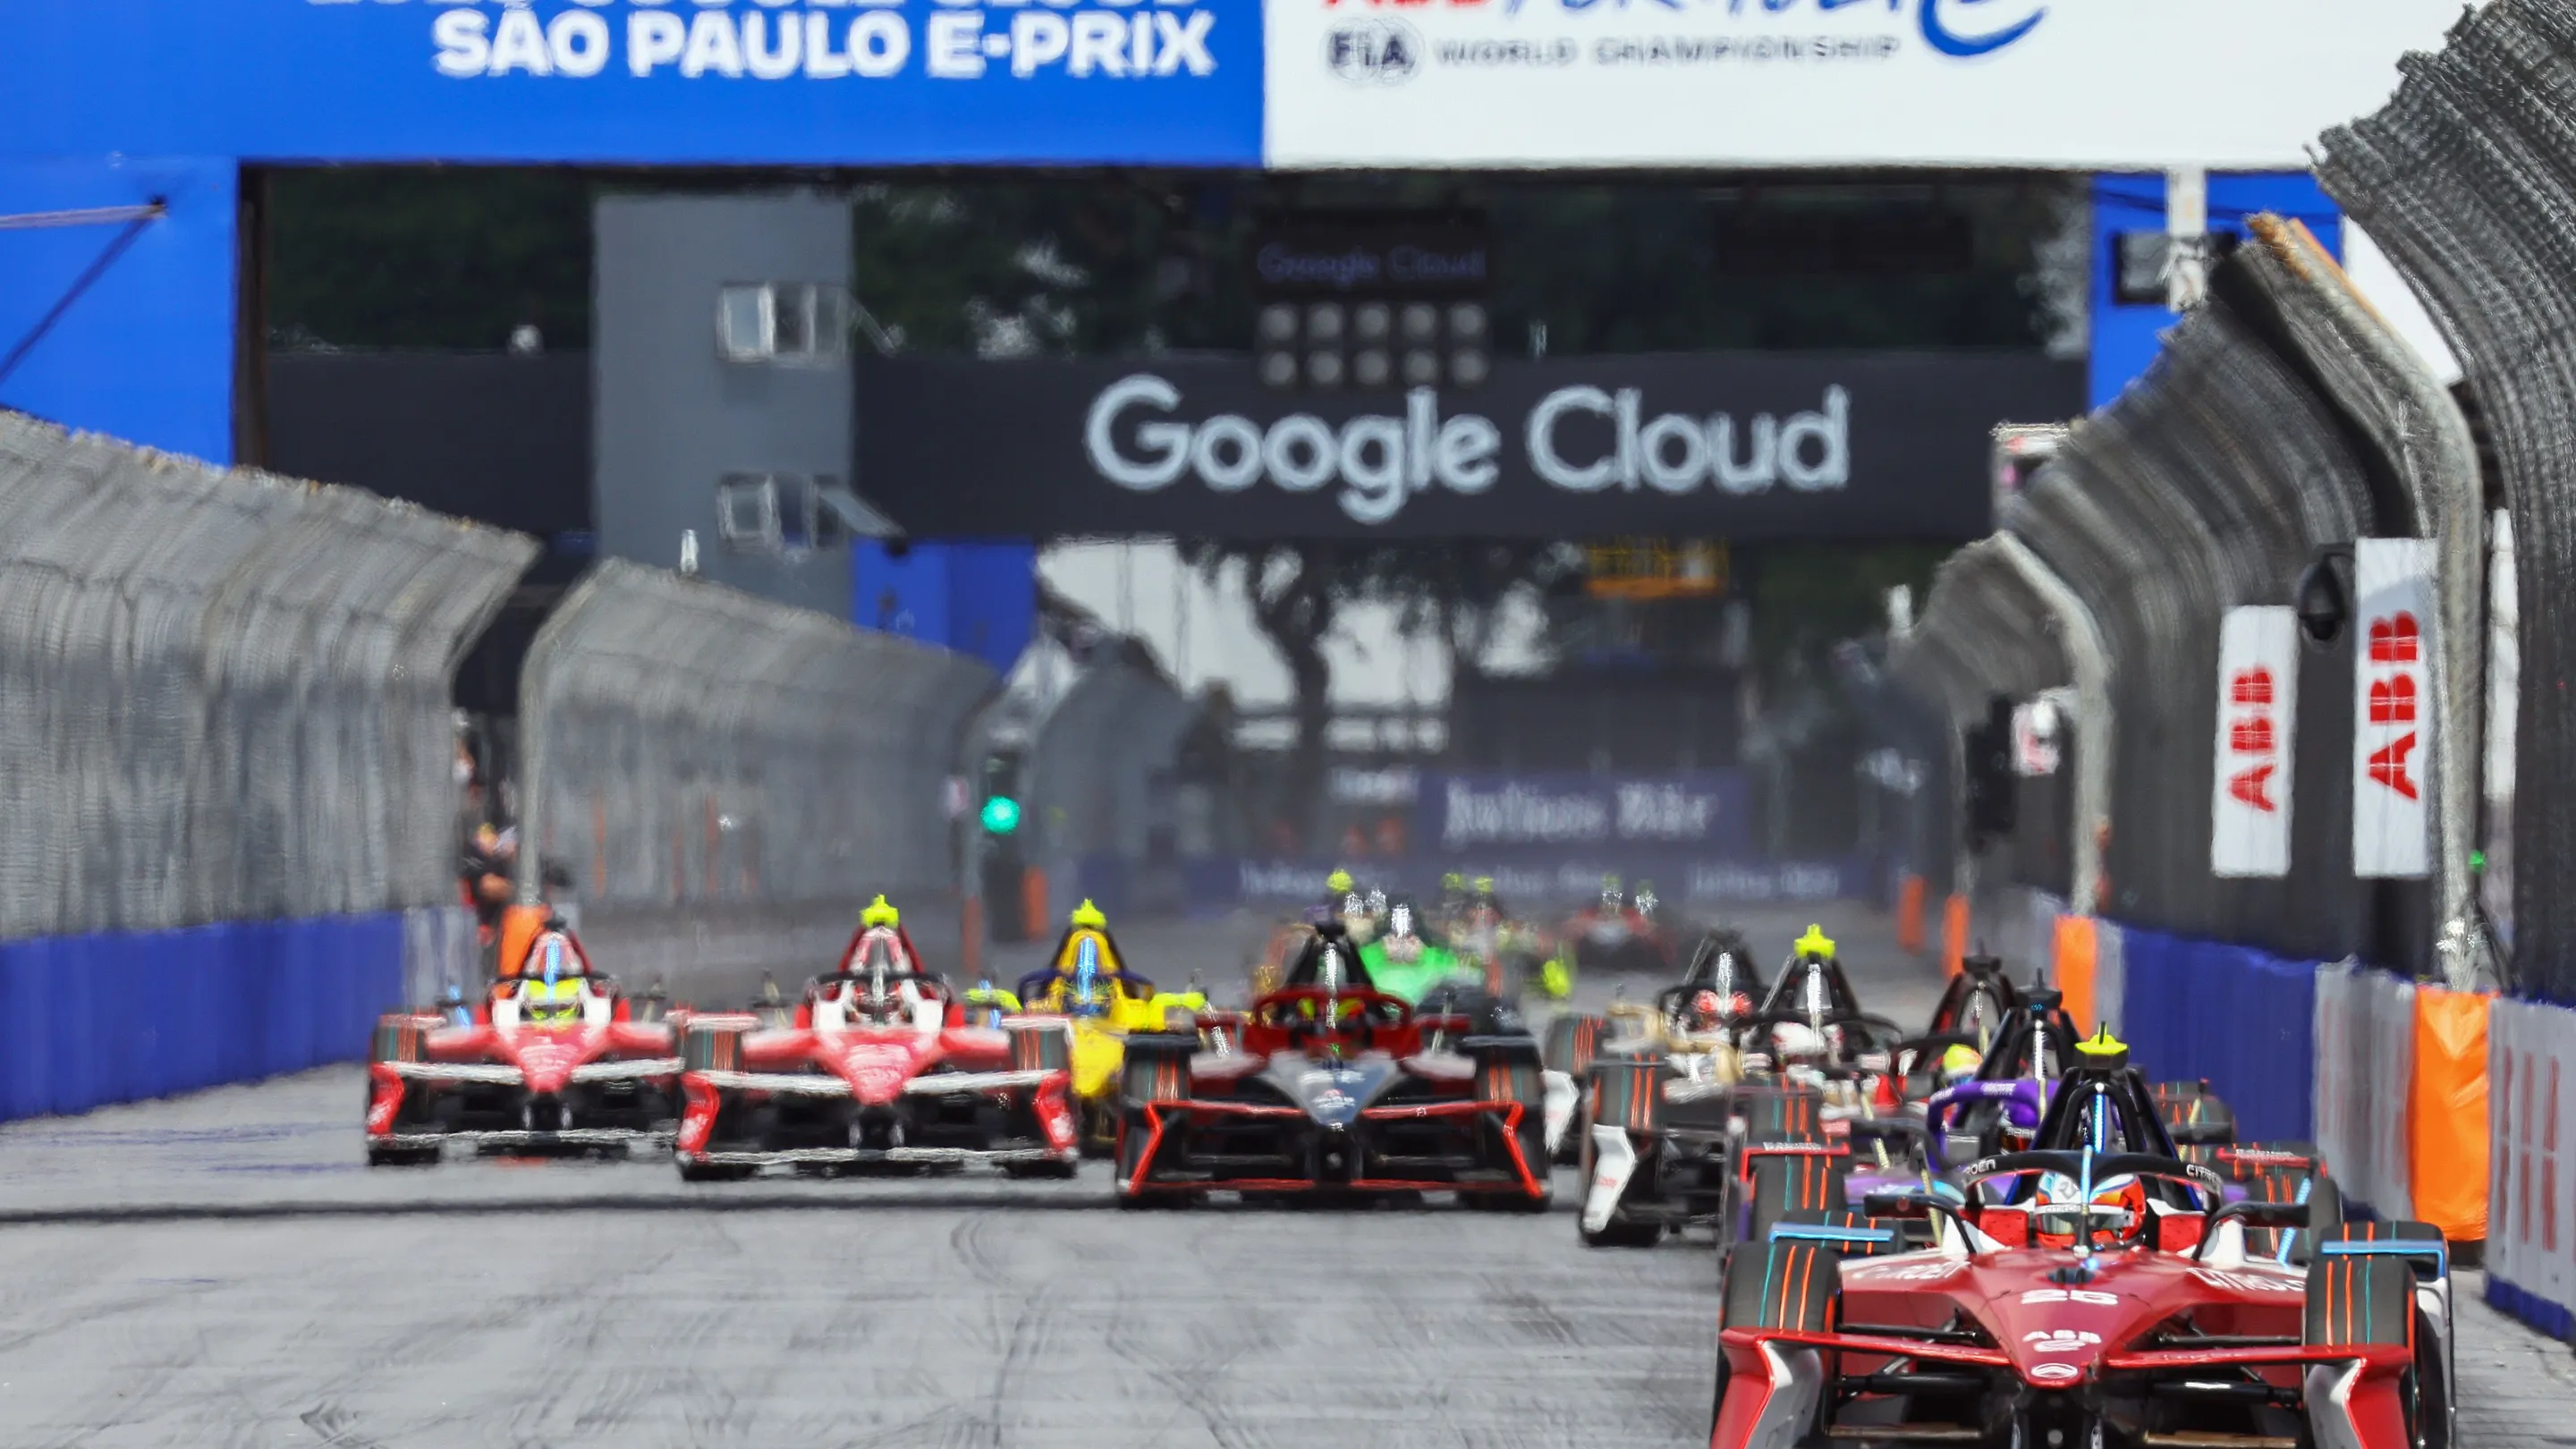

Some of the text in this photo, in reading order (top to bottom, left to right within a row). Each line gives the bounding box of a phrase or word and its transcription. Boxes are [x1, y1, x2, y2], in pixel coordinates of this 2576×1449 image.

[627, 10, 911, 80] PAULO
[927, 11, 1215, 79] E-PRIX
[1327, 30, 1901, 73] FIA WORLD CHAMPIONSHIP
[1086, 373, 1851, 523] Google Cloud
[2229, 667, 2275, 812] ABB
[2367, 610, 2419, 802] ABB
[2020, 1288, 2119, 1305] 25
